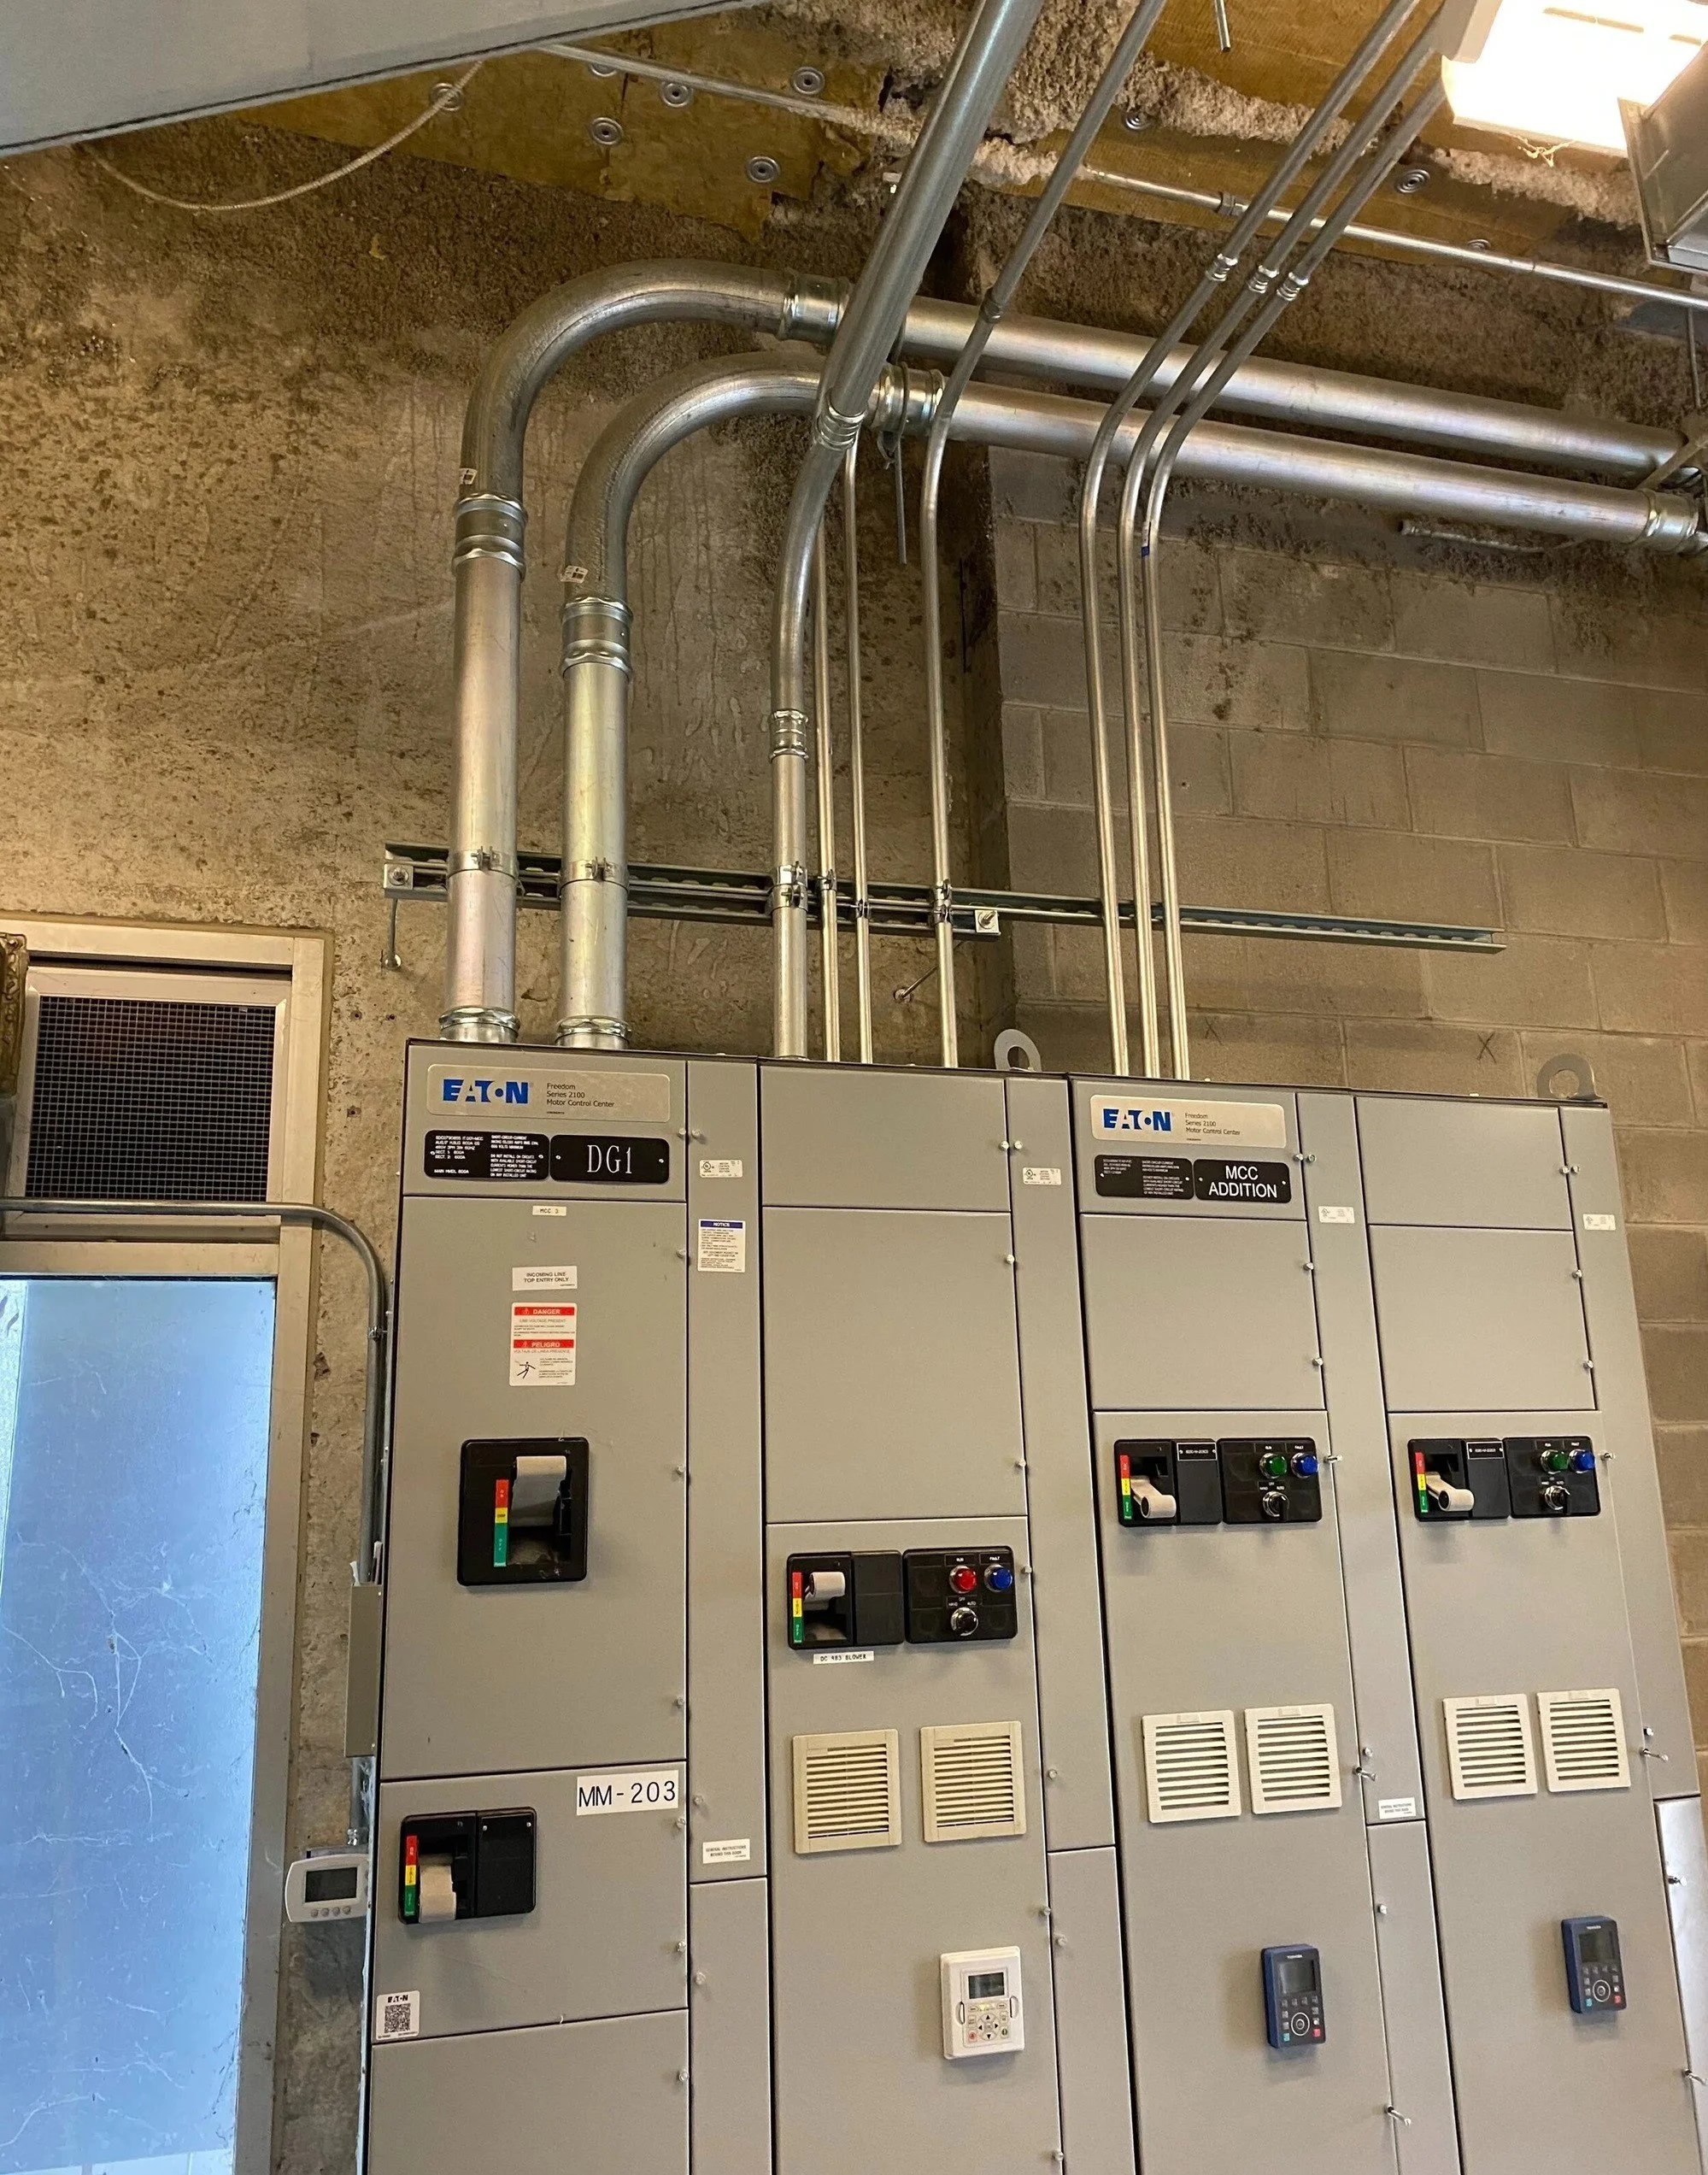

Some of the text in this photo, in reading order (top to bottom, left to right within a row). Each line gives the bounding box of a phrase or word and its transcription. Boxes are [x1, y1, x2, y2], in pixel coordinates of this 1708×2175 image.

[443, 1079, 529, 1103] EATON
[1103, 1108, 1171, 1132] EATON
[587, 1145, 631, 1173] DG1
[1225, 1165, 1259, 1180] MCC
[1209, 1182, 1277, 1198] ADDITION
